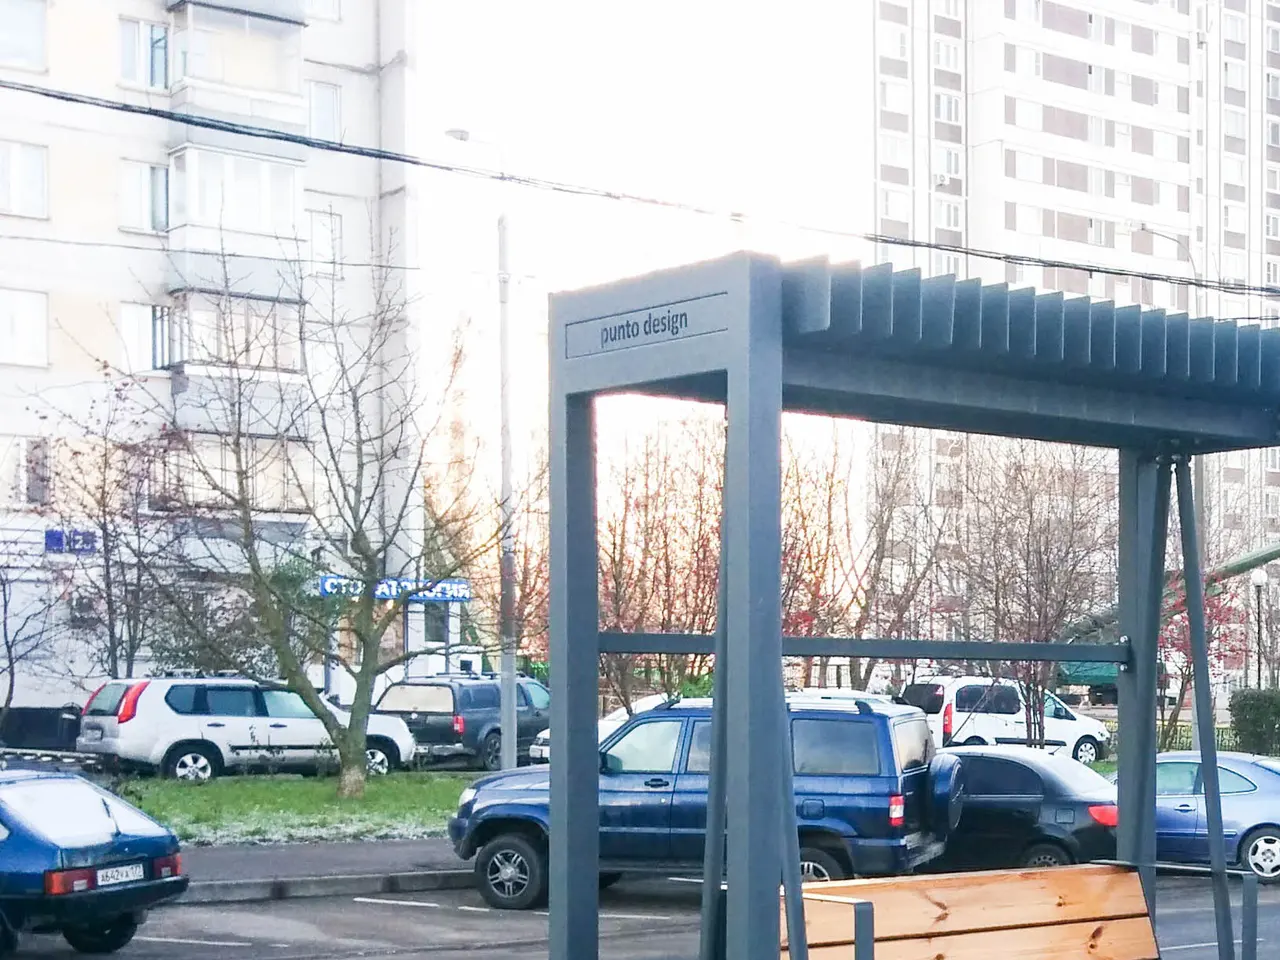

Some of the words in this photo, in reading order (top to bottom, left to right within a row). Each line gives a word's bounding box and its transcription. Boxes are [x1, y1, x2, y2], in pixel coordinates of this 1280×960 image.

[600, 320, 640, 348] punto
[643, 310, 688, 335] design
[324, 579, 470, 599] СТОАТОЛОГИЯ
